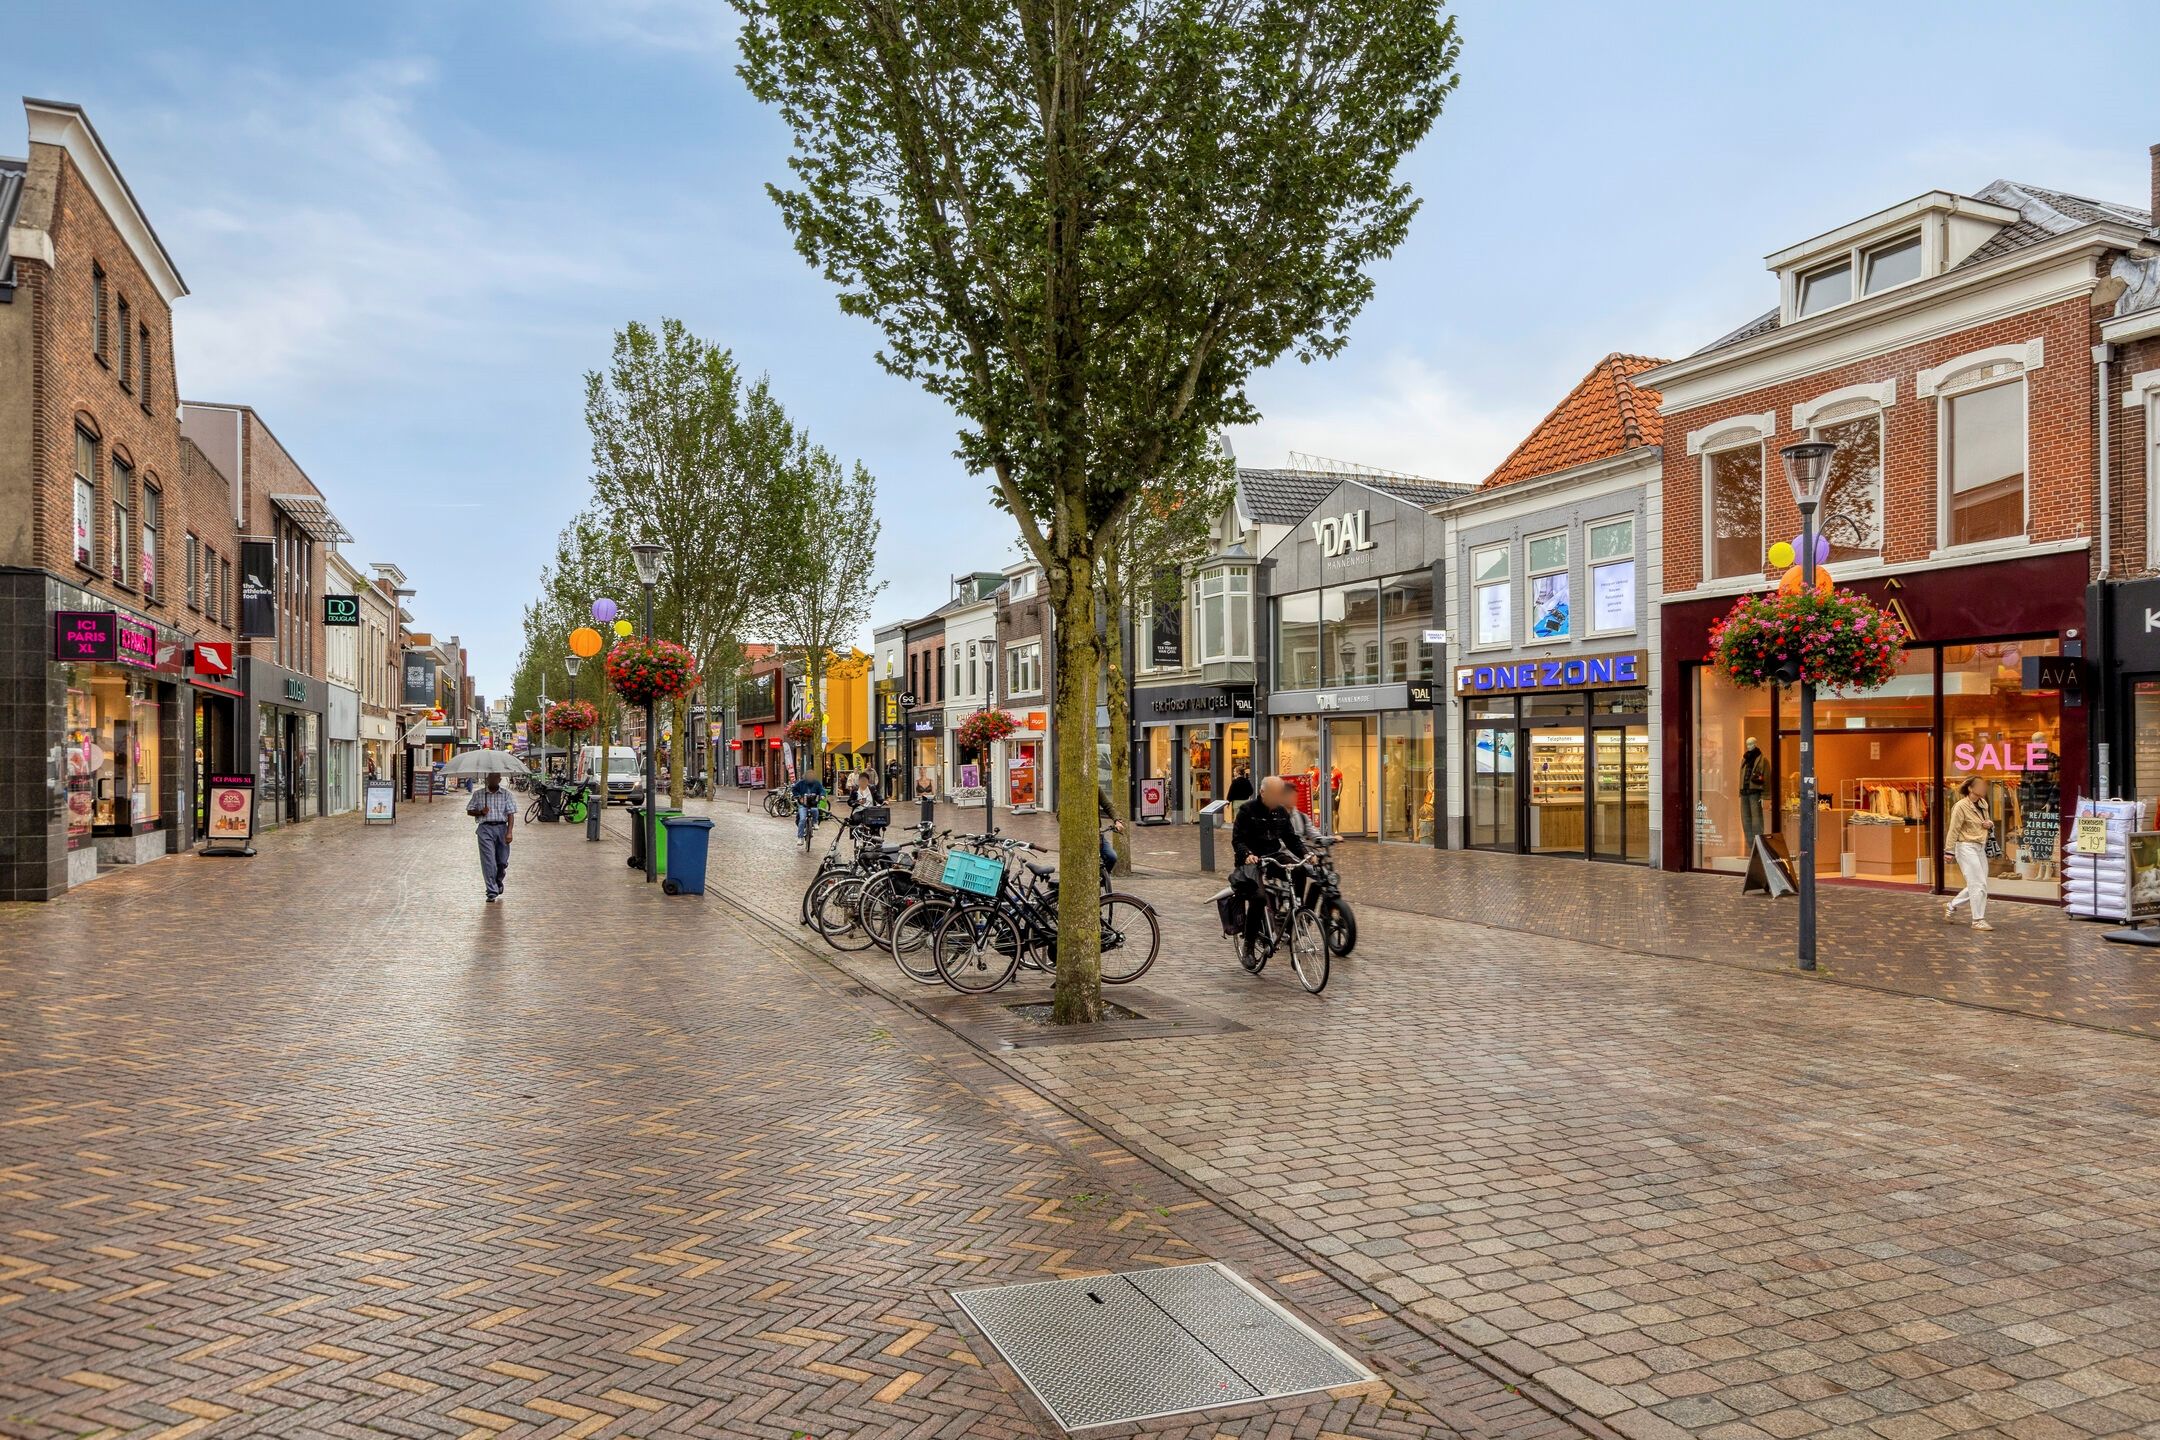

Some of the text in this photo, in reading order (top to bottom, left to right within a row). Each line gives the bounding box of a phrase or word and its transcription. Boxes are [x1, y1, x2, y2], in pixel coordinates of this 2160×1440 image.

[1327, 553, 1375, 570] MANNENMODE
[77, 620, 97, 630] ICI
[67, 631, 106, 642] PARIS
[79, 643, 96, 653] XL
[1151, 695, 1229, 712] TER HORST VAN GEEL
[1953, 743, 2049, 771] SALE
[2029, 811, 2060, 820] RE/DONE
[2026, 820, 2060, 829] XIRENA
[2023, 829, 2060, 837] GESTUZ
